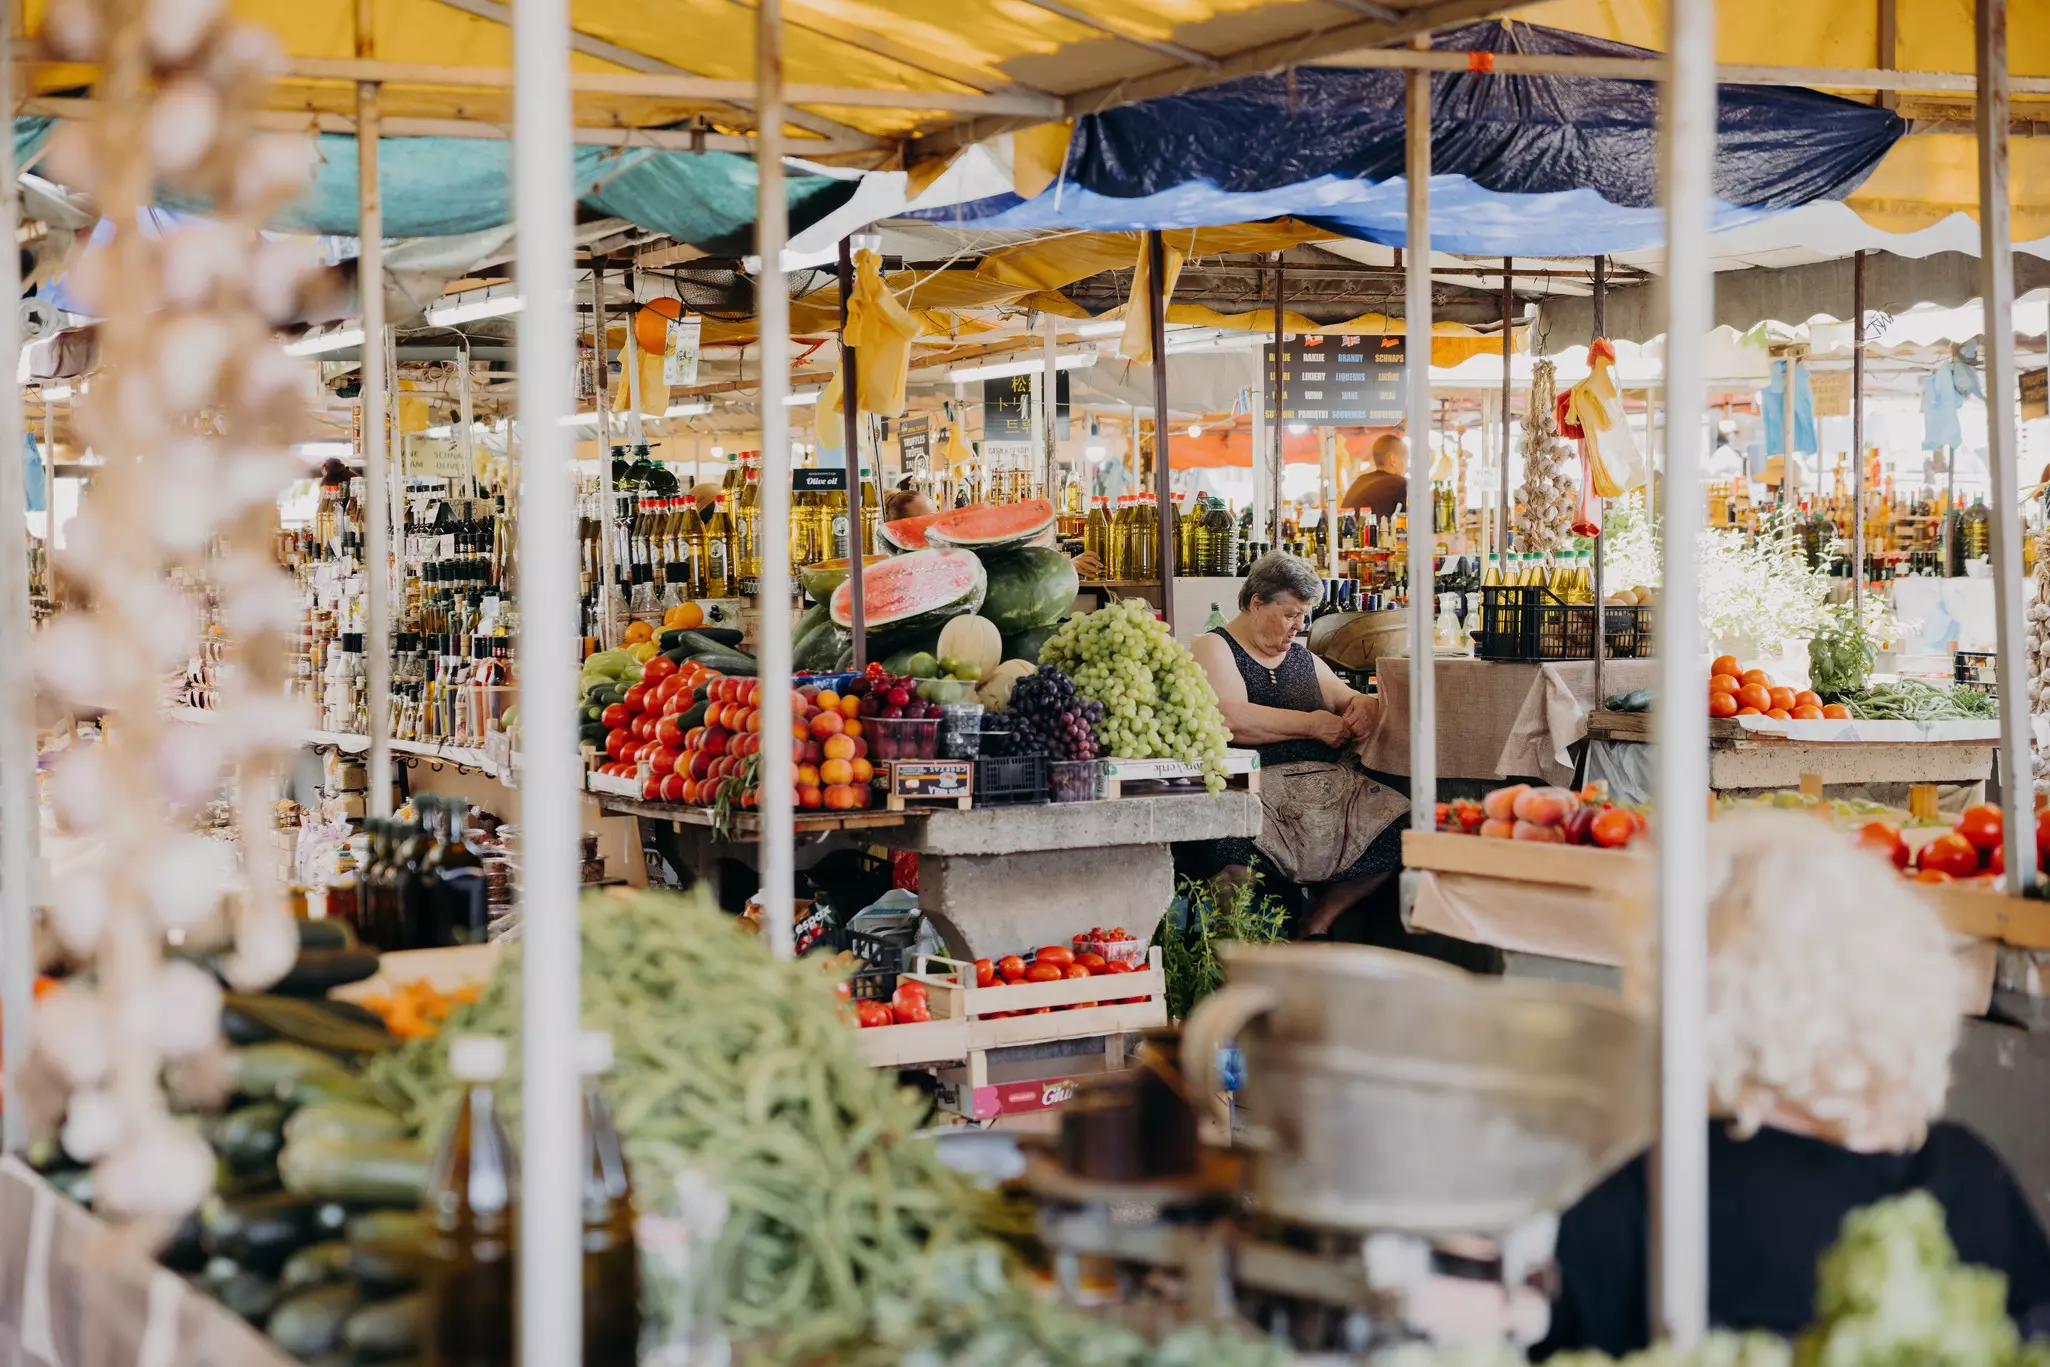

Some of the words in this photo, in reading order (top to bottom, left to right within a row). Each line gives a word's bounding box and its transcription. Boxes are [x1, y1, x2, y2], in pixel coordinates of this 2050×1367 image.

[1337, 353, 1364, 363] BRANDY
[1374, 353, 1405, 363] SCHNAPS
[1335, 372, 1366, 382] LIQUEURS
[903, 435, 926, 448] TRUFFLES
[806, 477, 827, 485] Olive
[827, 477, 838, 485] oil
